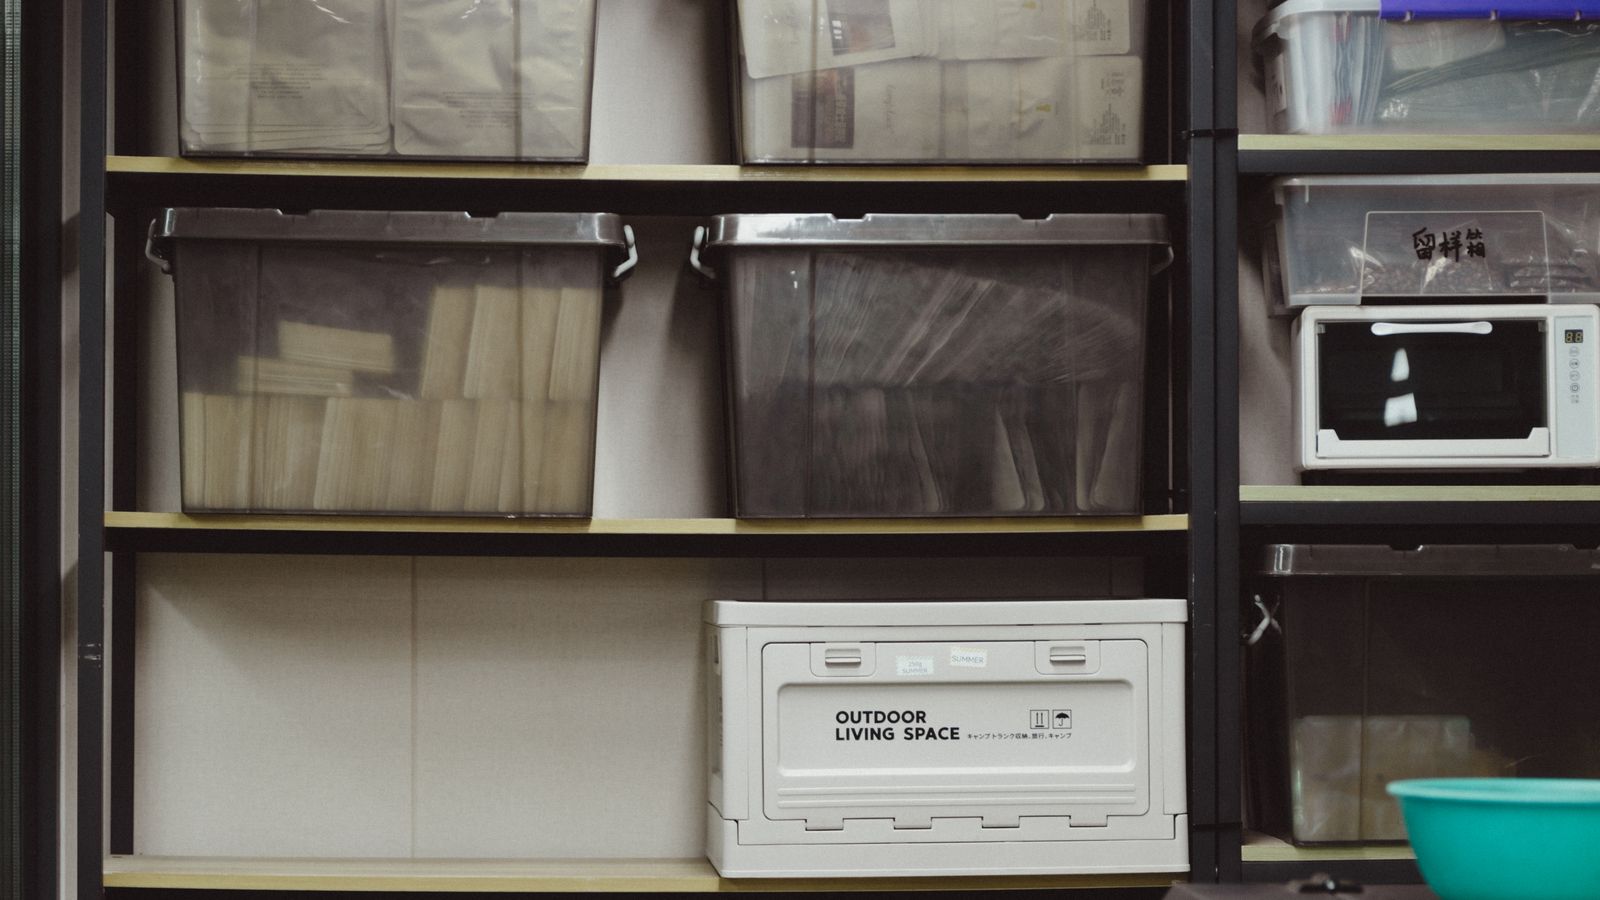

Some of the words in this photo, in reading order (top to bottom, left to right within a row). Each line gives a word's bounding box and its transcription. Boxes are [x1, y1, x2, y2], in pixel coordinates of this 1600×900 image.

[1412, 227, 1486, 262] 留样箱
[951, 655, 984, 664] SUMMER
[836, 711, 926, 724] OUTDOOR
[836, 727, 894, 740] LIVING
[904, 727, 960, 740] SPACE
